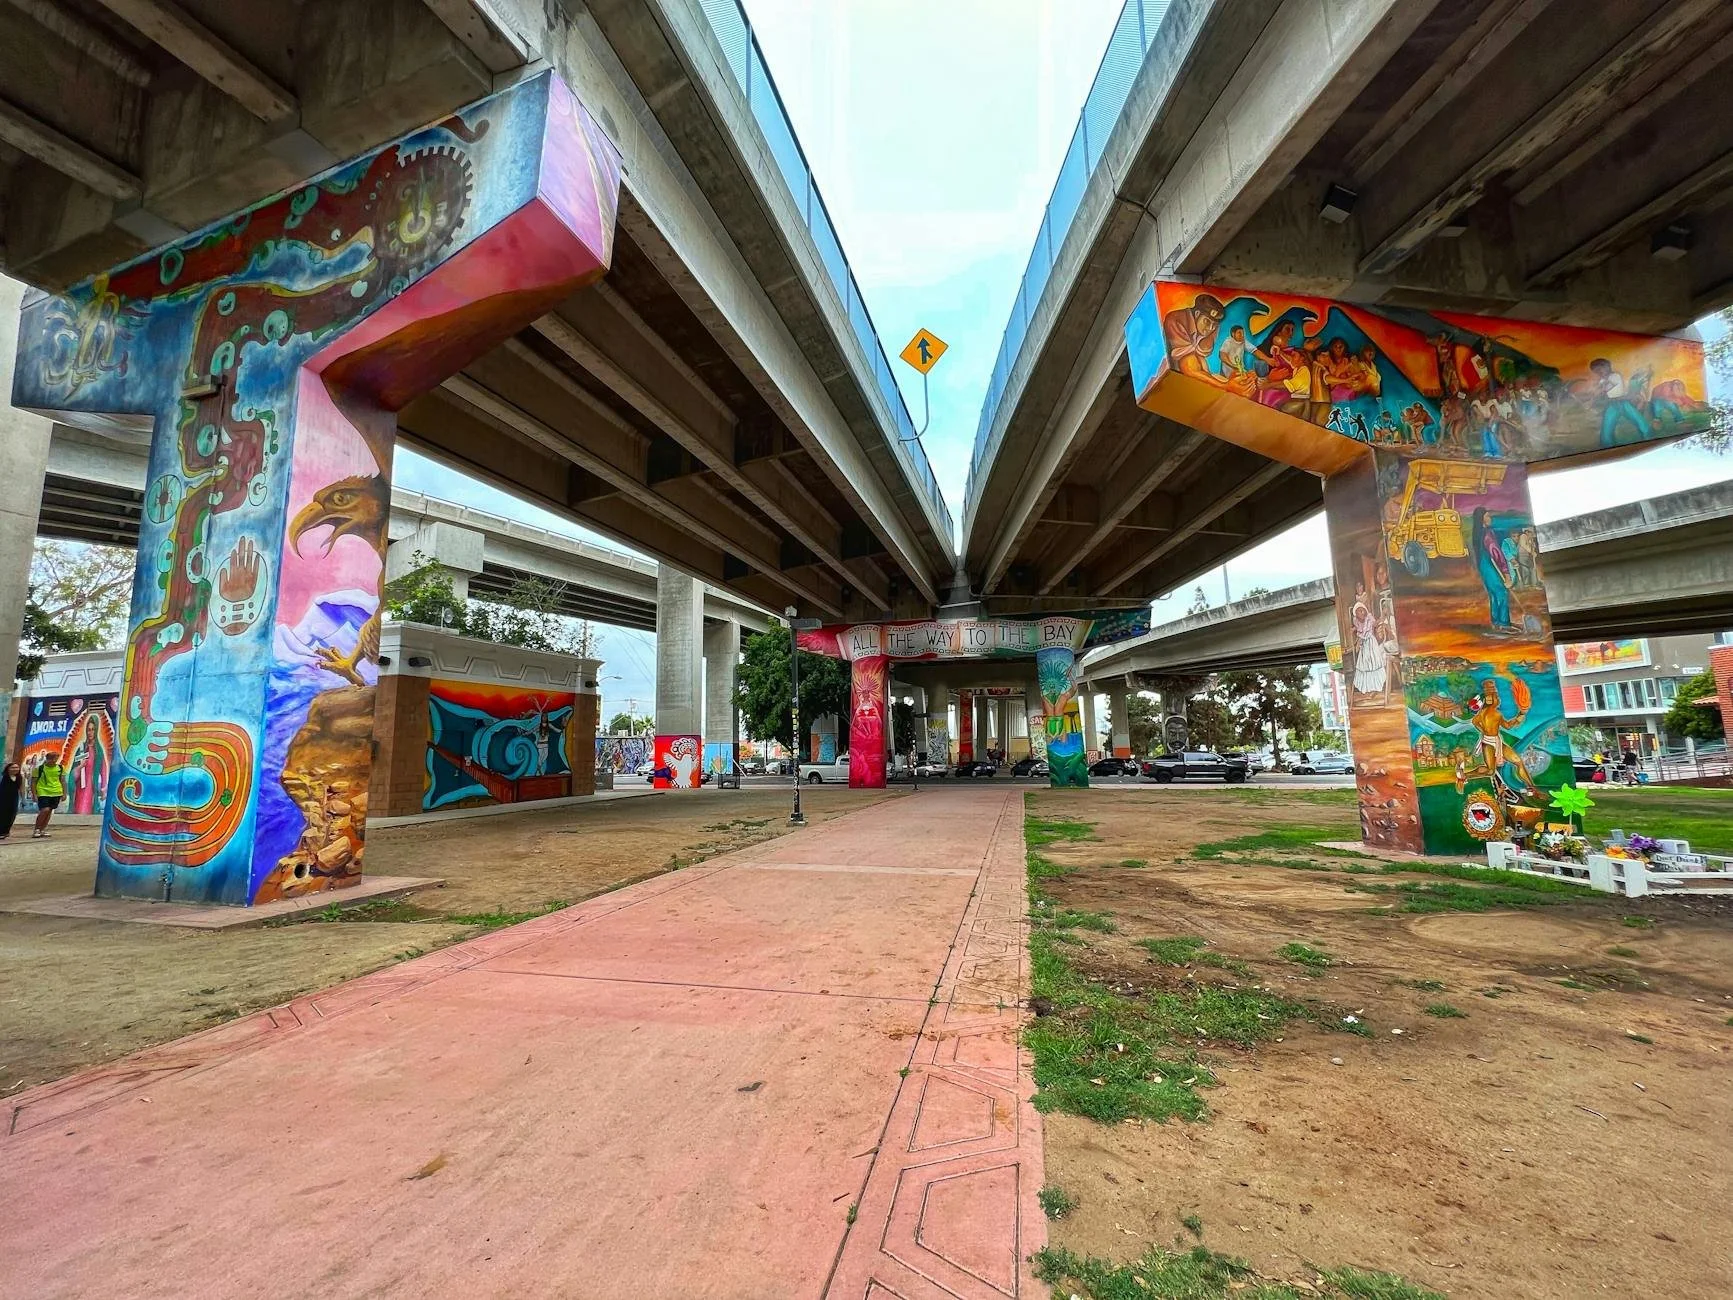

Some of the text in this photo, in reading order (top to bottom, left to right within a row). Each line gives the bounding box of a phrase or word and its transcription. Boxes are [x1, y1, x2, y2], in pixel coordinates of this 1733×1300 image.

[853, 623, 1076, 652] ALL THE WAY TO THE BAY
